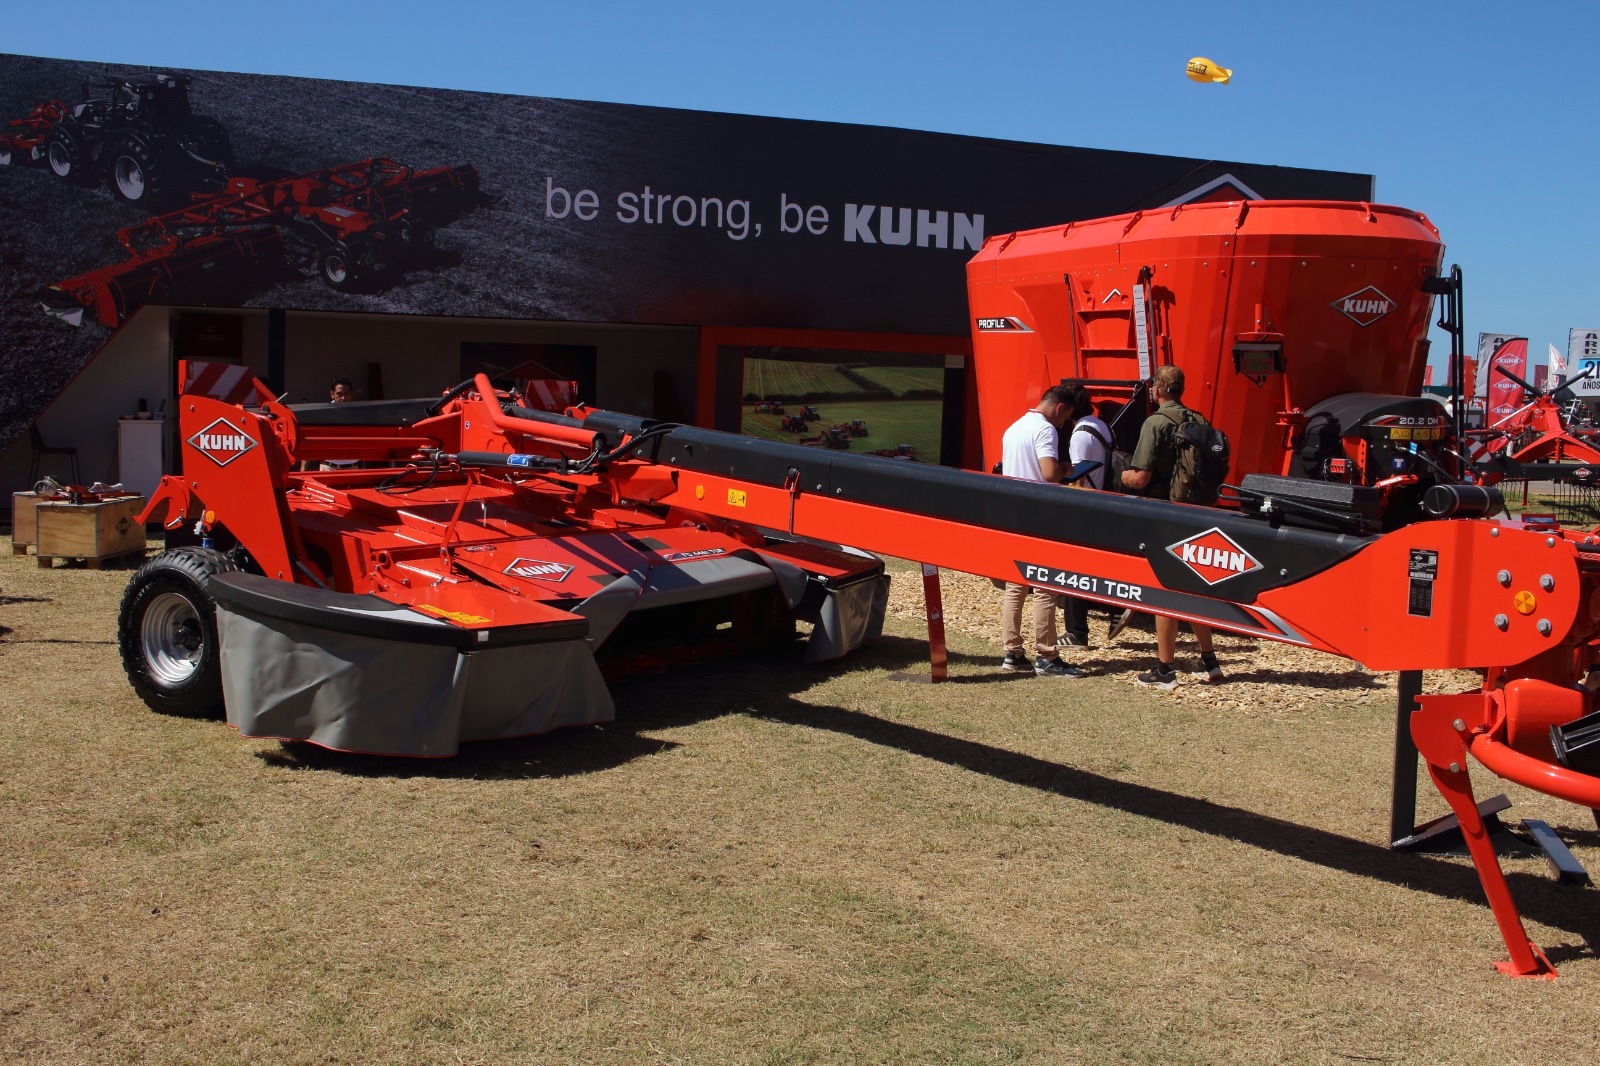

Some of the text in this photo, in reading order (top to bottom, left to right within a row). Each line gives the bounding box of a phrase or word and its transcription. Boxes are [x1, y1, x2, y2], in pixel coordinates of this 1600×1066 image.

[546, 177, 985, 251] be strong, be KUHN
[1343, 299, 1389, 313] KUHN
[978, 319, 1005, 329] PROFILE
[1399, 417, 1425, 425] 20.2
[200, 434, 245, 451] KUHN
[1182, 543, 1246, 572] KUHN
[511, 563, 568, 576] KUHN
[1026, 565, 1142, 602] FC 4461 TCR
